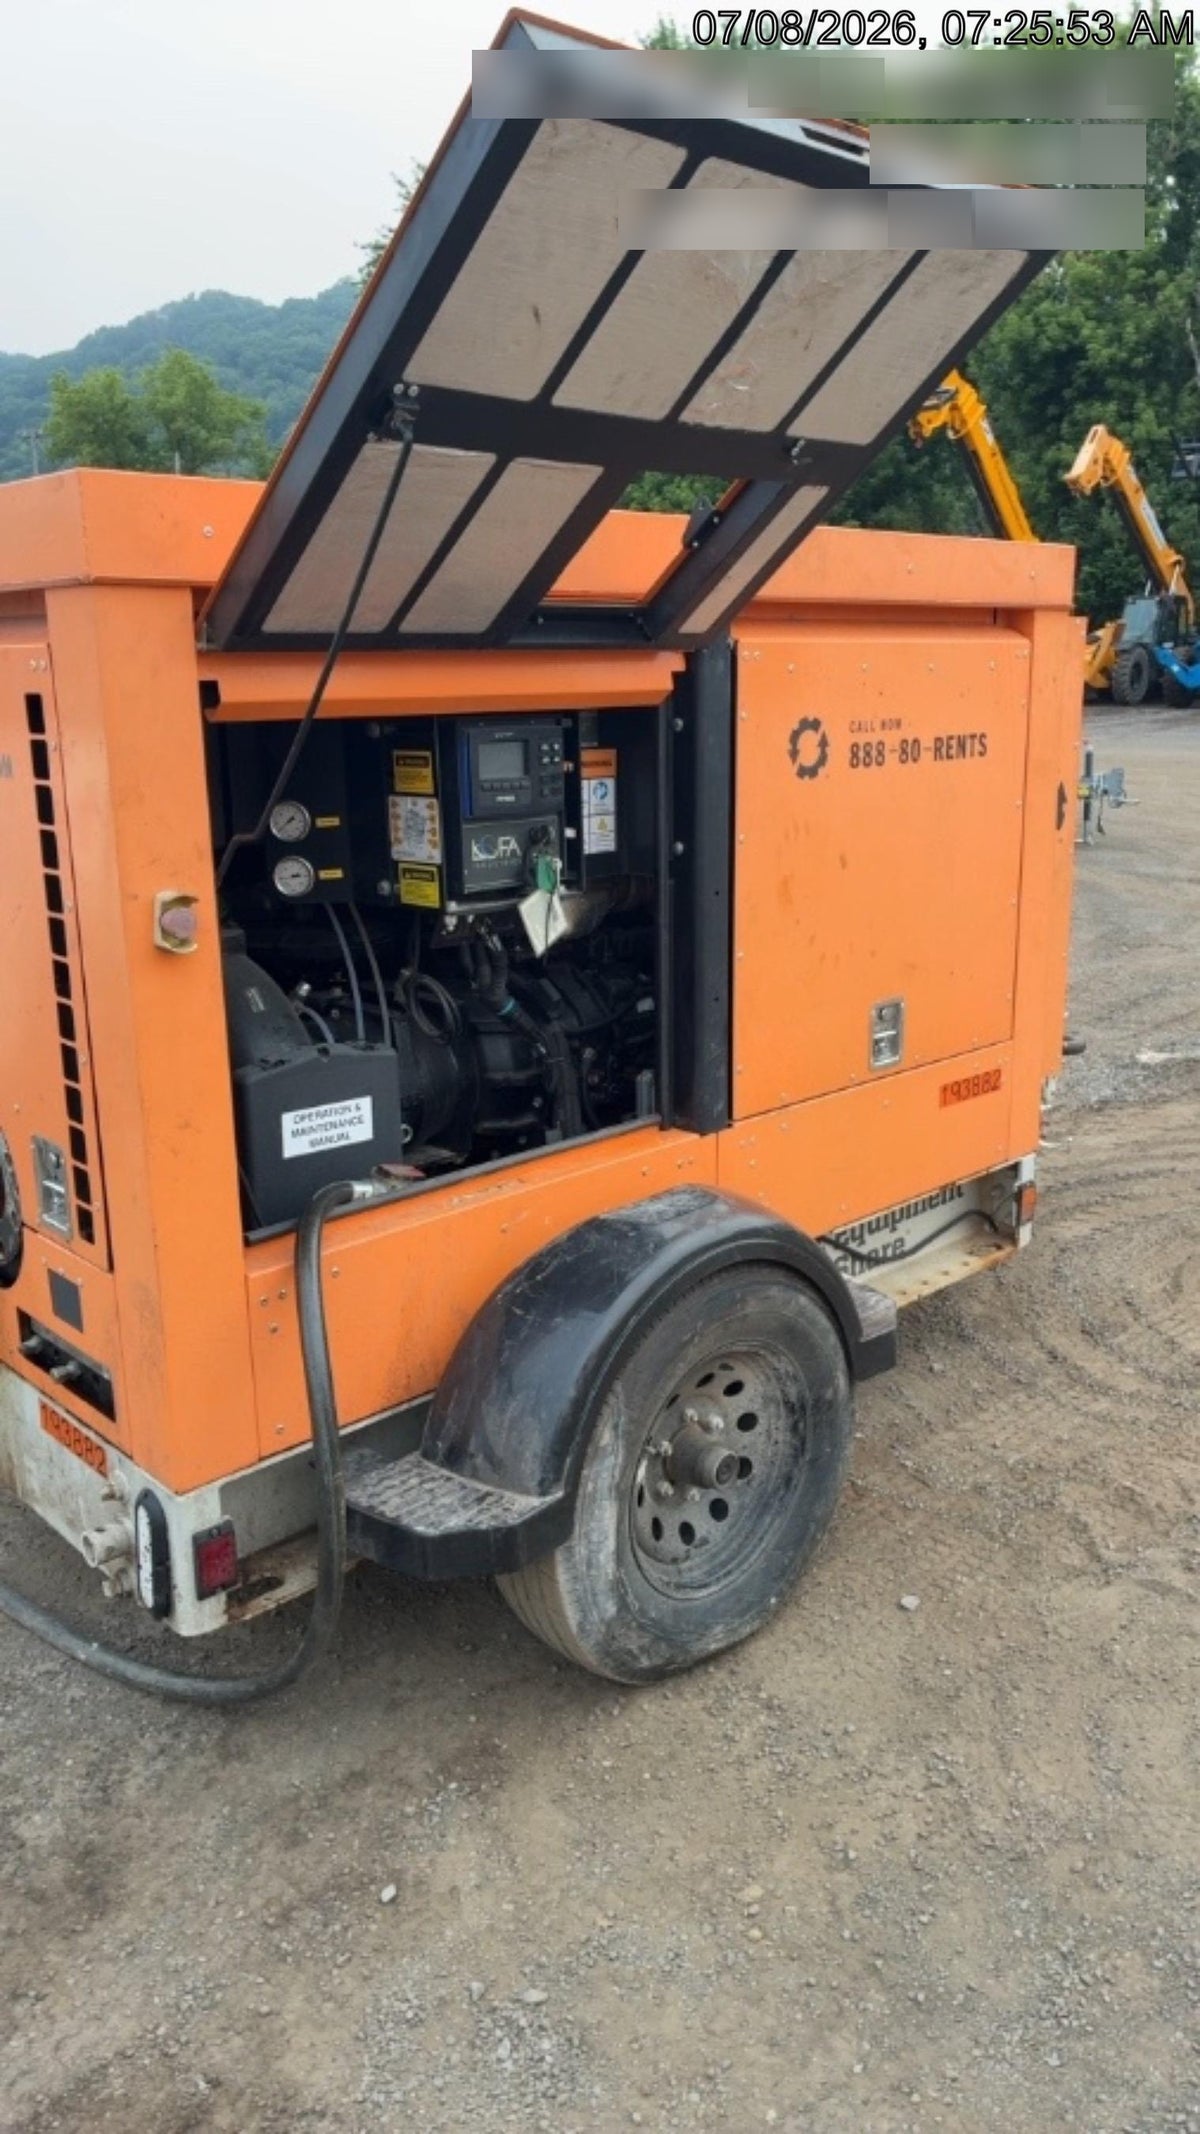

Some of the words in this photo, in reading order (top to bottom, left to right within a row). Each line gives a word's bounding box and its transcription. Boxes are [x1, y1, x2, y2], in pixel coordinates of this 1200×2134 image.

[849, 720, 876, 734] CALL
[880, 718, 902, 731] NOW
[849, 732, 988, 769] 888-80-RENTS
[942, 1069, 1002, 1107] 193882
[293, 1105, 352, 1125] OPERATION
[291, 1114, 364, 1139] MAINTENANCE
[309, 1132, 351, 1148] MANUAL
